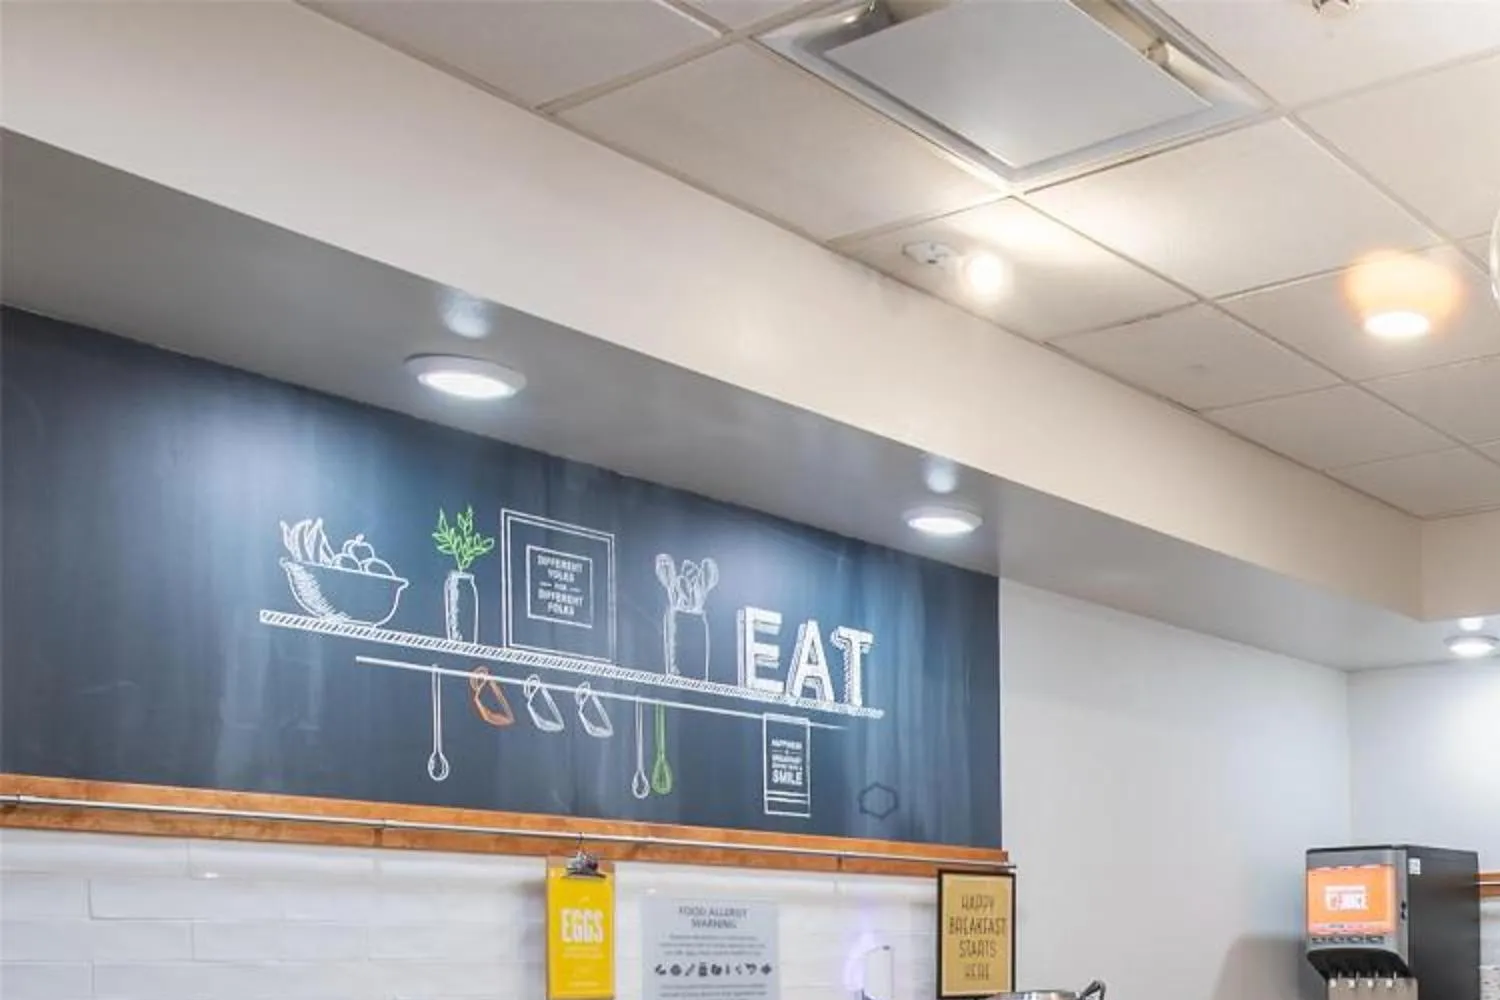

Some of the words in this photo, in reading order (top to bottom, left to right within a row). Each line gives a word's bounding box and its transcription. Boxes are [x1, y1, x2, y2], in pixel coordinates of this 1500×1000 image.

[736, 606, 874, 706] EAT
[772, 769, 803, 786] SMILE
[709, 906, 749, 919] ALLERGY
[961, 894, 995, 912] HAPPY
[561, 907, 604, 944] EGGS
[948, 915, 1007, 936] BREAKFAST
[959, 939, 998, 959] STARTS
